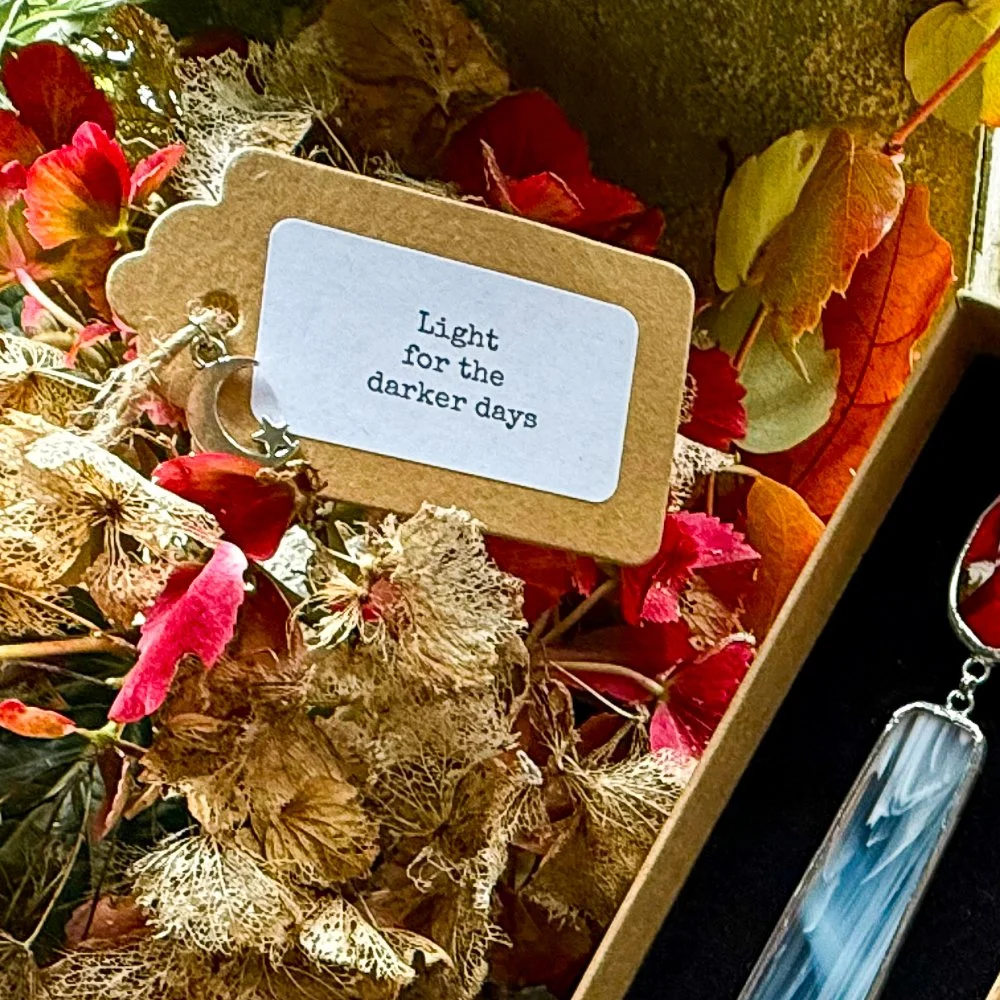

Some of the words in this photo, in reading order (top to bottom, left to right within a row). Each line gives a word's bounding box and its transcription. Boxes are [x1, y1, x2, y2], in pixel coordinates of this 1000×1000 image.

[416, 309, 500, 352] Light
[401, 344, 450, 374] for
[458, 356, 505, 387] the
[367, 371, 467, 412] darker
[475, 396, 538, 430] days
